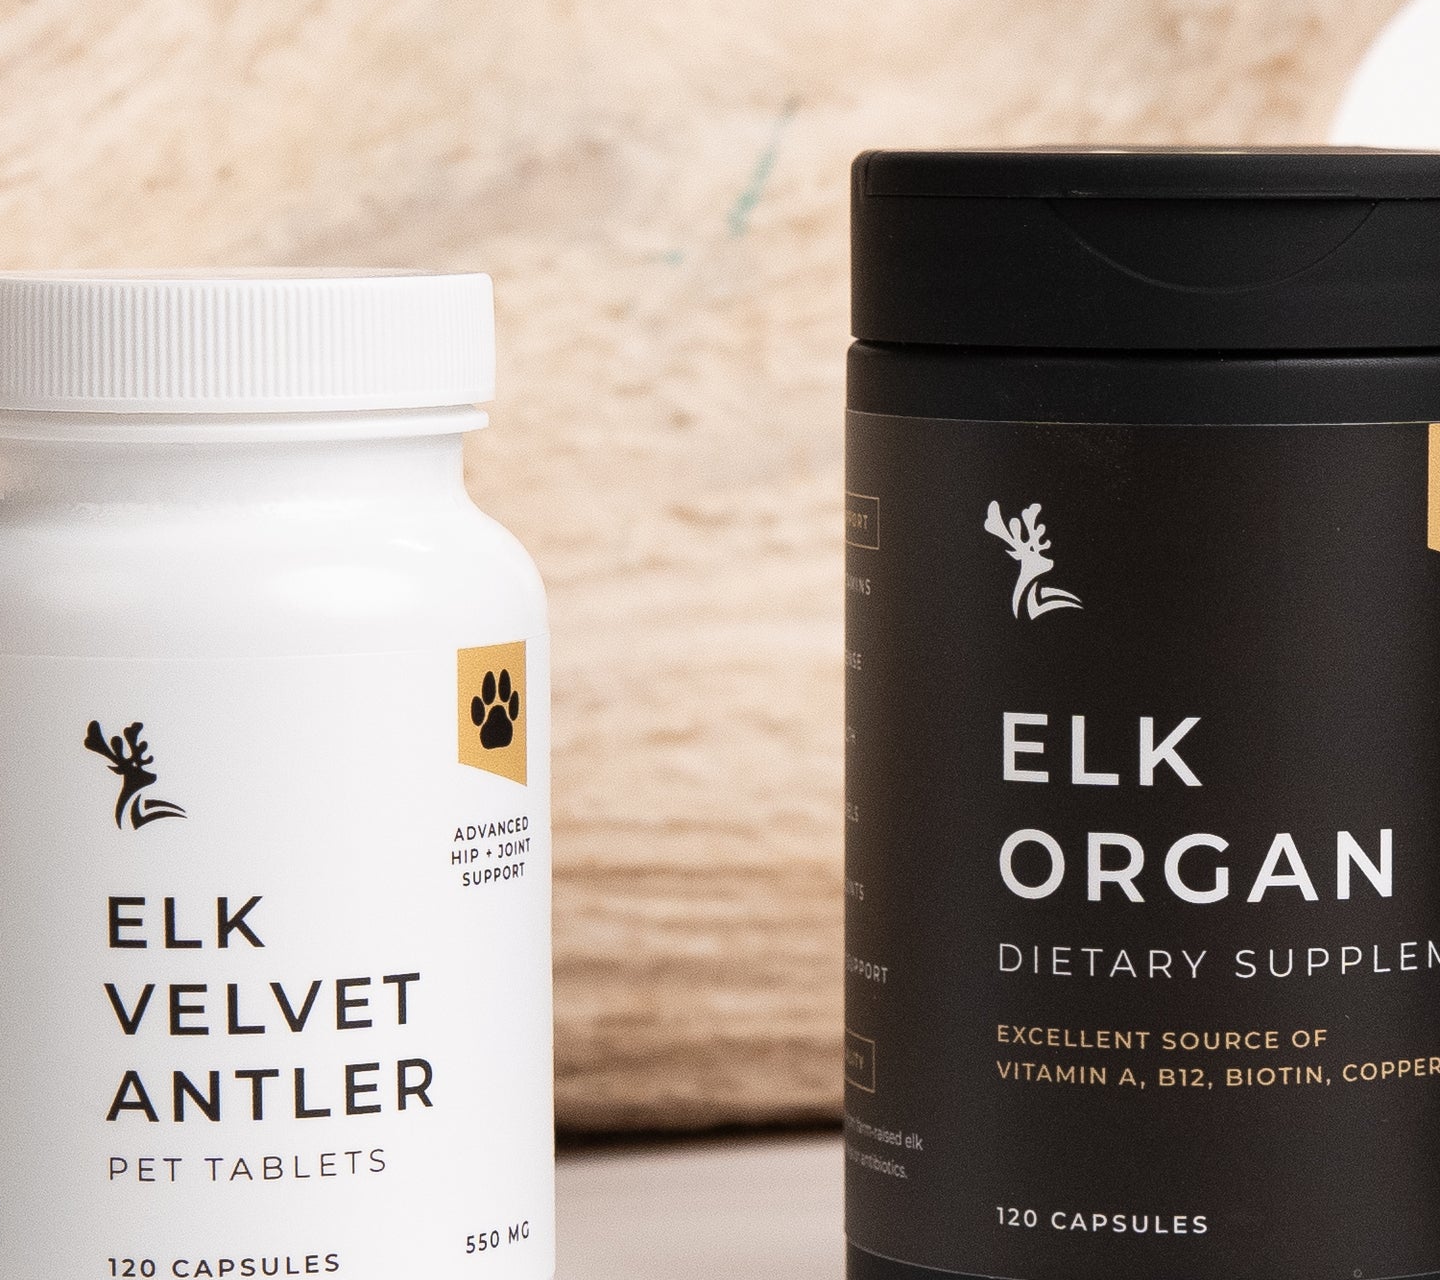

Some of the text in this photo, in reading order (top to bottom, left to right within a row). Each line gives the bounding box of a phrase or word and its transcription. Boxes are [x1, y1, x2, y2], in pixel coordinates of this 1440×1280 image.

[1002, 711, 1203, 787] ELK
[453, 815, 529, 842] ADVANCED
[451, 848, 479, 865] HIP
[497, 837, 531, 859] JOINT
[998, 828, 1394, 905] ORGAN
[462, 862, 526, 887] SUPPORT
[107, 895, 266, 949] ELK
[998, 942, 1208, 979] DIETARY
[103, 972, 421, 1036] VELVET
[996, 1024, 1328, 1051] EXCELLENT SOURCE OF
[104, 1057, 435, 1123] ANTLER
[996, 1060, 1108, 1086] VITAMIN
[1118, 1066, 1147, 1091] A,
[1158, 1067, 1214, 1091] B12,
[1225, 1065, 1333, 1088] BIOTIN,
[108, 1148, 388, 1183] PET TABLETS
[996, 1206, 1209, 1235] 120 CAPSULES
[465, 1221, 531, 1255] 550 MG
[107, 1253, 341, 1279] 120 CAPSULES
